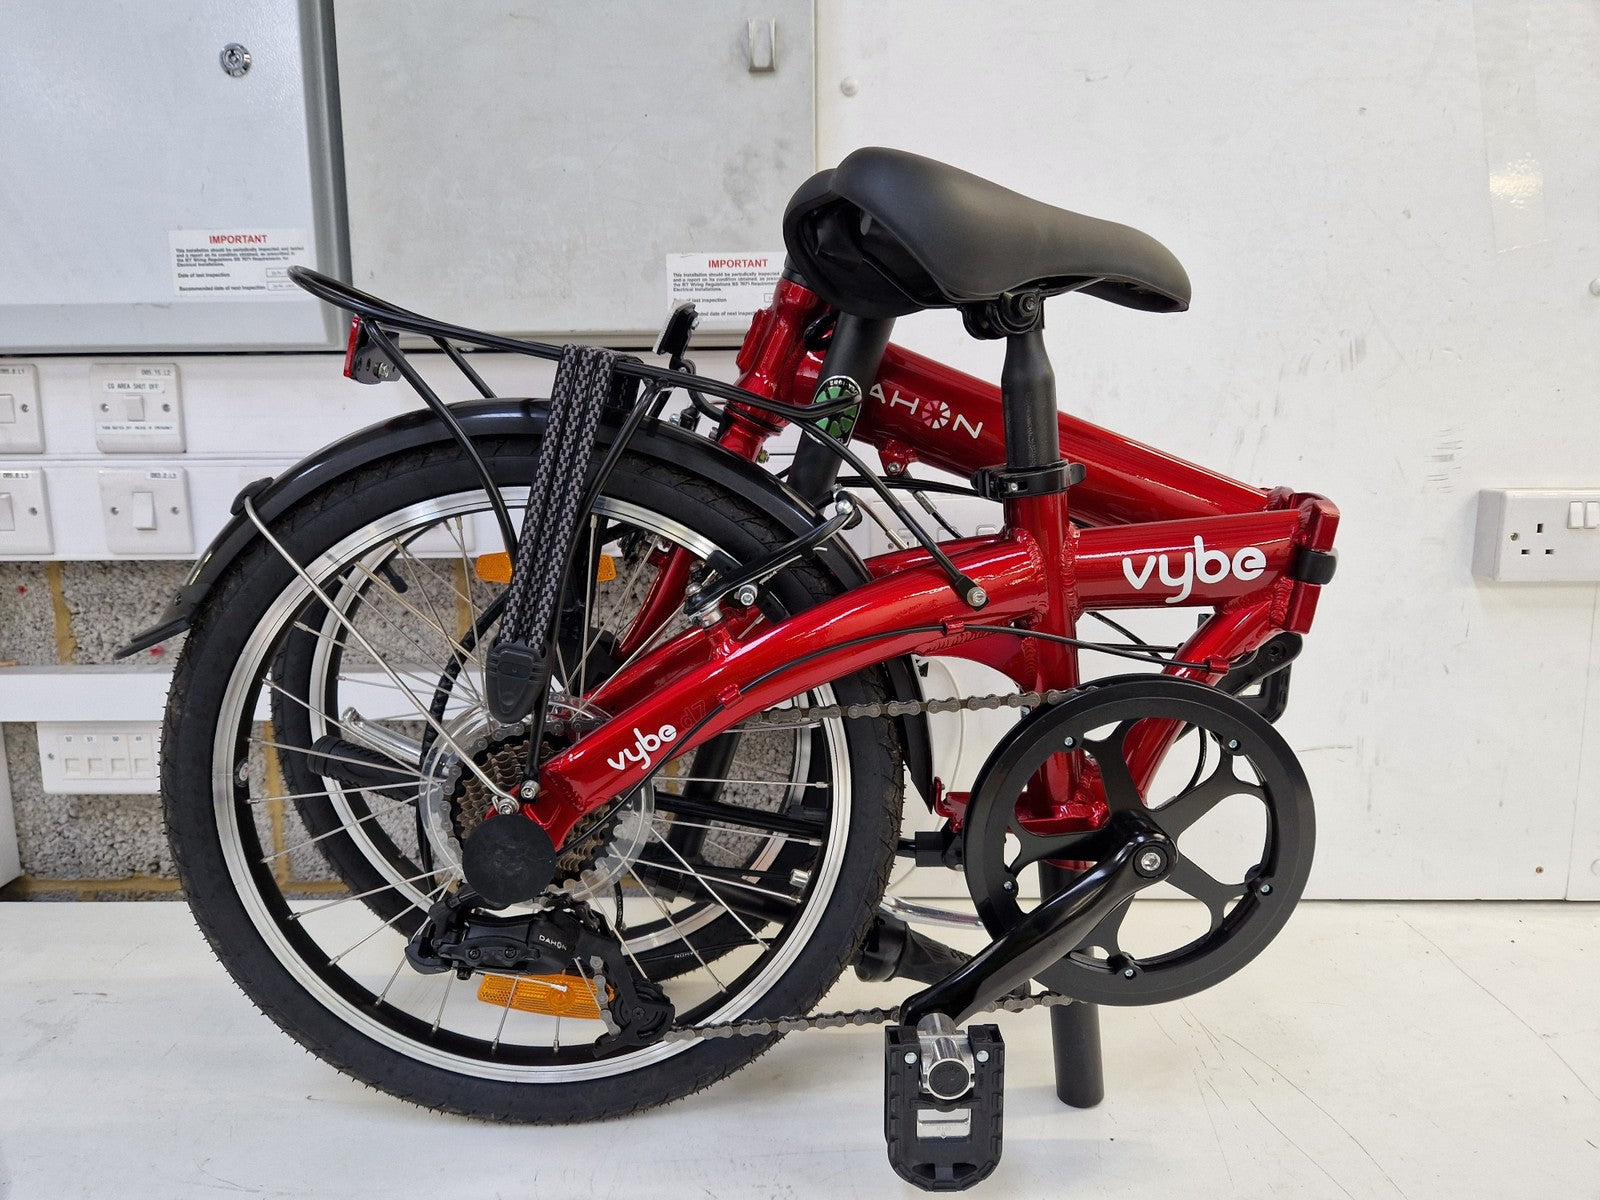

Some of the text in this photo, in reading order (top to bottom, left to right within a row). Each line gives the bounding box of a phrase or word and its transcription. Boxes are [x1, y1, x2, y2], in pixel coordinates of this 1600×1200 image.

[209, 234, 268, 244] IMPORTANT
[708, 259, 768, 268] IMPORTANT
[1122, 535, 1266, 604] vybe
[607, 724, 677, 770] vybe
[539, 934, 567, 950] DAHON
